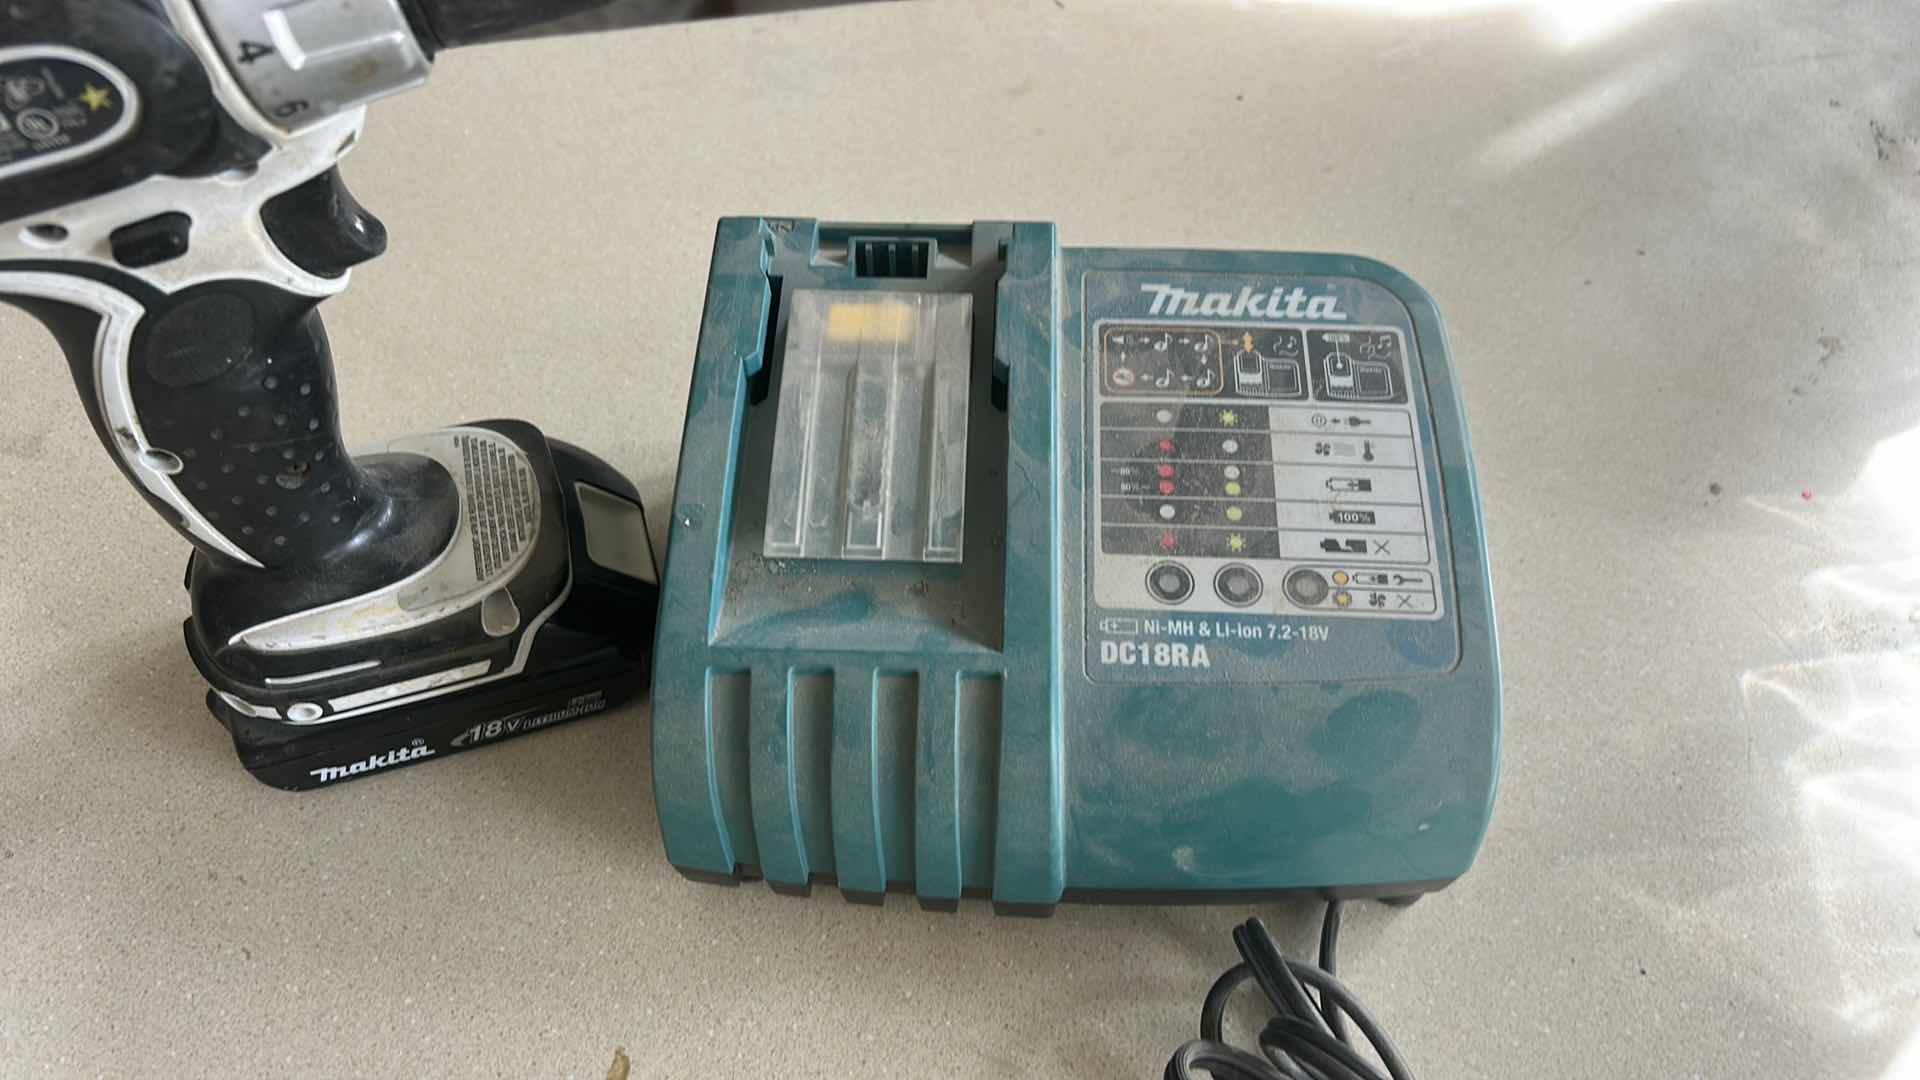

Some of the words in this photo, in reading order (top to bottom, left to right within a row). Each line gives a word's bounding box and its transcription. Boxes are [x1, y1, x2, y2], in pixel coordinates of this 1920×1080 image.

[238, 42, 275, 64] 4
[1144, 619, 1194, 635] Ni-MH
[1199, 621, 1212, 636] &
[1267, 624, 1329, 641] 7.2-18V
[1100, 641, 1211, 668] DC18RA
